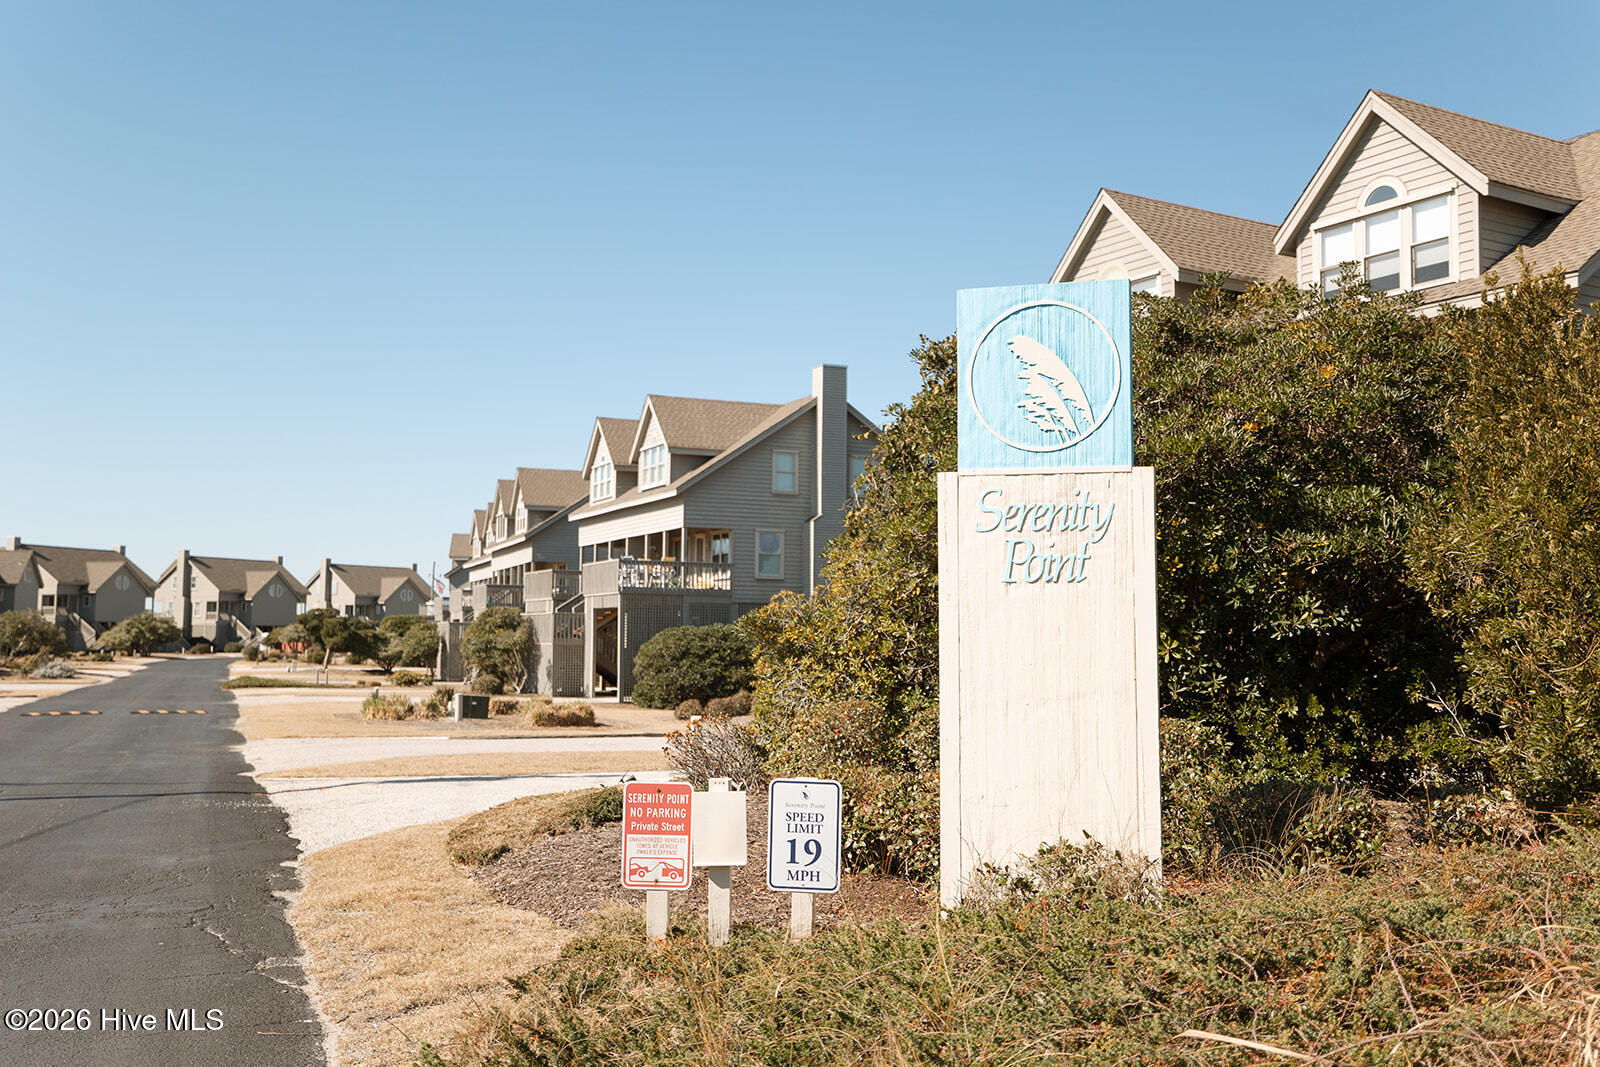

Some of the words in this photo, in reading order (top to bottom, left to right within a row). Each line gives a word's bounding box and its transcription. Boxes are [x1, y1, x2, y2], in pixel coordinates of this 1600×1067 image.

[975, 488, 1115, 543] Serenity
[1001, 538, 1091, 584] Point
[628, 793, 664, 804] SERENITY
[667, 794, 689, 804] POINT
[630, 808, 643, 818] NO
[646, 808, 687, 818] PARKING
[785, 812, 825, 823] SPEED
[631, 821, 659, 831] Private
[661, 822, 685, 832] Street
[787, 823, 824, 834] LIMIT
[786, 838, 822, 867] 19
[787, 869, 821, 882] MPH
